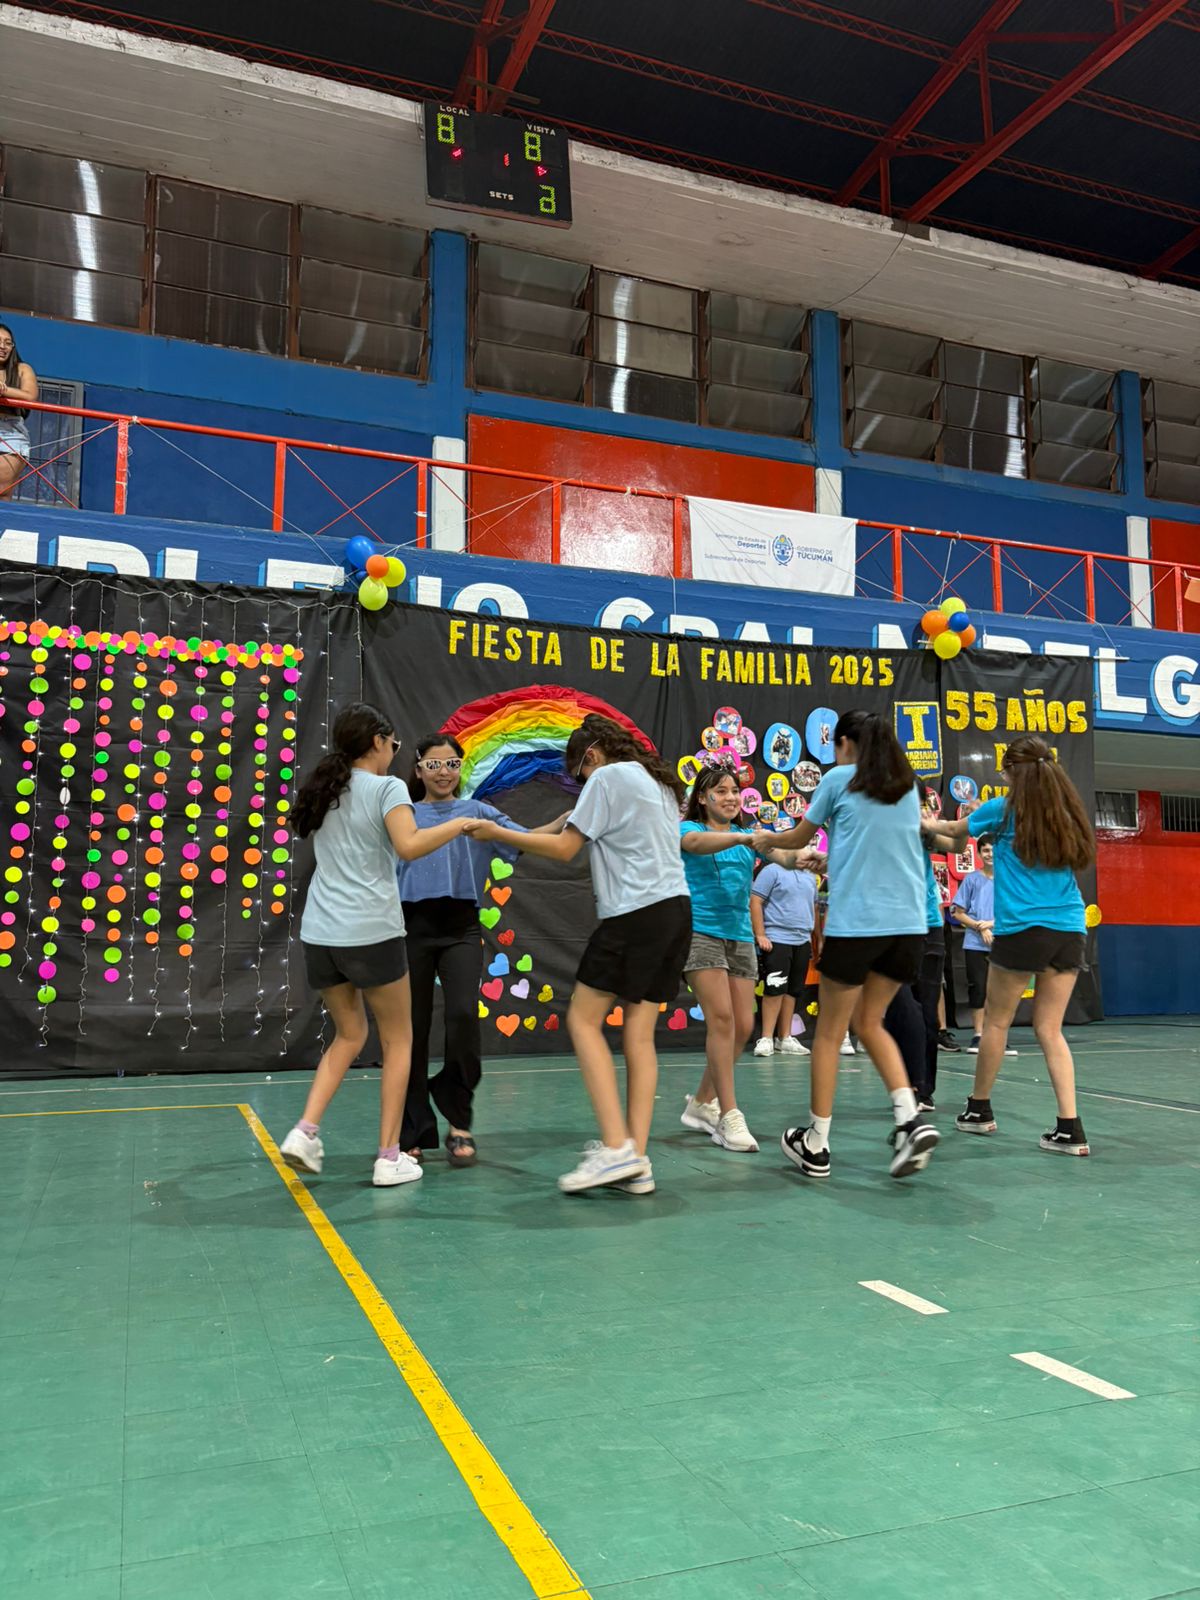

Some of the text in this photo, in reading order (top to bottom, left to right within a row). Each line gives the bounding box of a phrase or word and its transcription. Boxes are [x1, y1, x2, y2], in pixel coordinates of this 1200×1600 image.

[440, 104, 470, 116] LOCAL
[436, 112, 455, 144] 8
[527, 124, 556, 136] VISITA
[524, 131, 542, 162] 8
[488, 190, 514, 200] SETS
[737, 541, 766, 550] Deportes
[797, 546, 825, 555] GOBIERNO
[797, 552, 833, 562] TUCUMÁN
[449, 620, 894, 687] FIESTA DE LA FAMILIA 2025
[946, 688, 1088, 734] 55 AÑOS
[902, 706, 933, 750] I
[908, 760, 938, 770] ORENO
